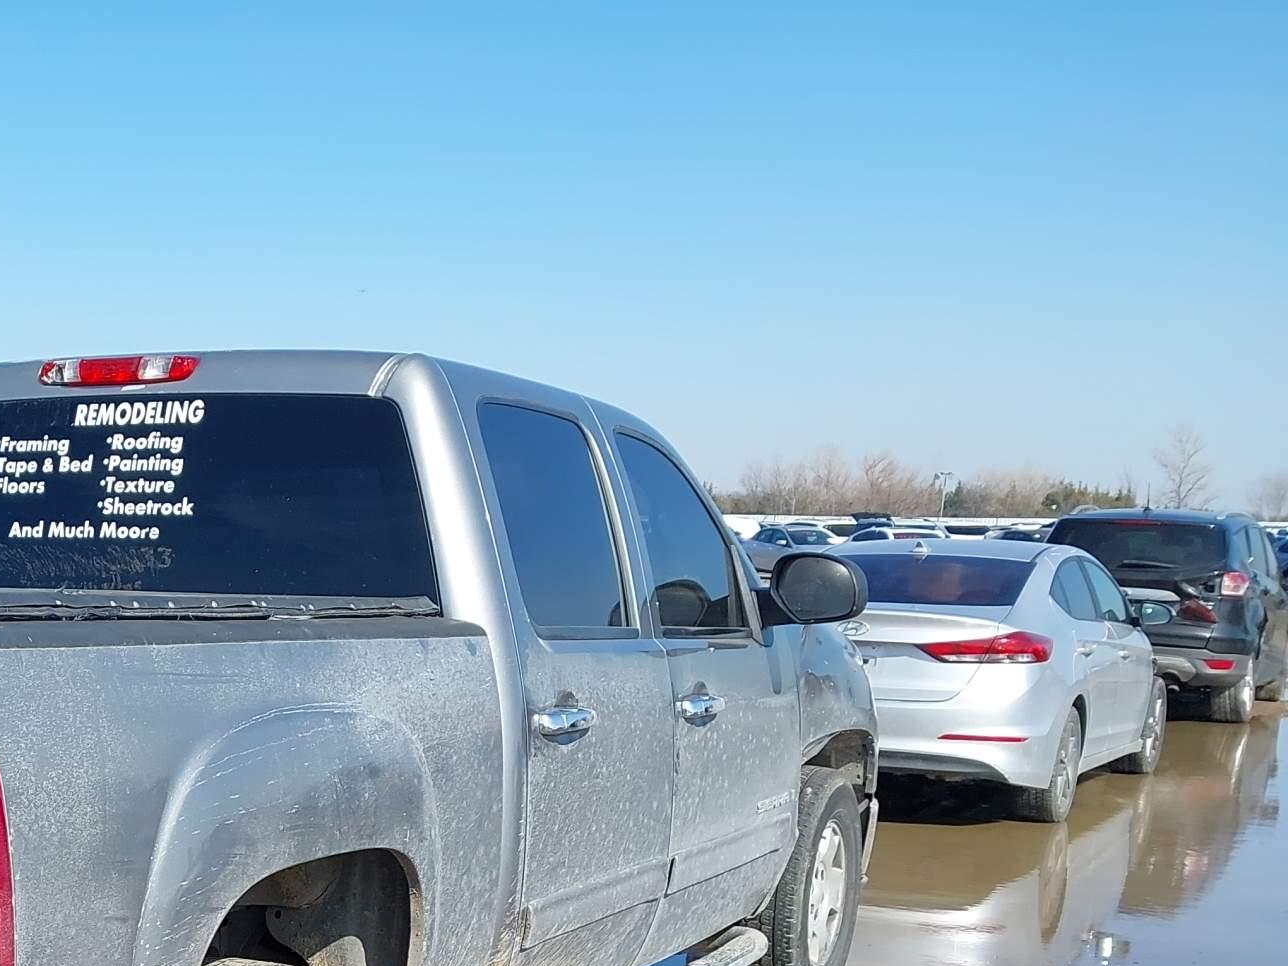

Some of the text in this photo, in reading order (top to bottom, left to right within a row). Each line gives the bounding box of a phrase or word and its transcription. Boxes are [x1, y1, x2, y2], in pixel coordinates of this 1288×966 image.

[74, 399, 205, 427] REMODELING
[0, 435, 70, 455] Framing
[112, 431, 184, 453] Roofing
[42, 457, 54, 473] &
[58, 454, 94, 472] Bed
[108, 453, 184, 476] Painting
[105, 476, 175, 494] Texture
[102, 496, 194, 516] Sheetrock
[8, 520, 160, 540] And Much Moore
